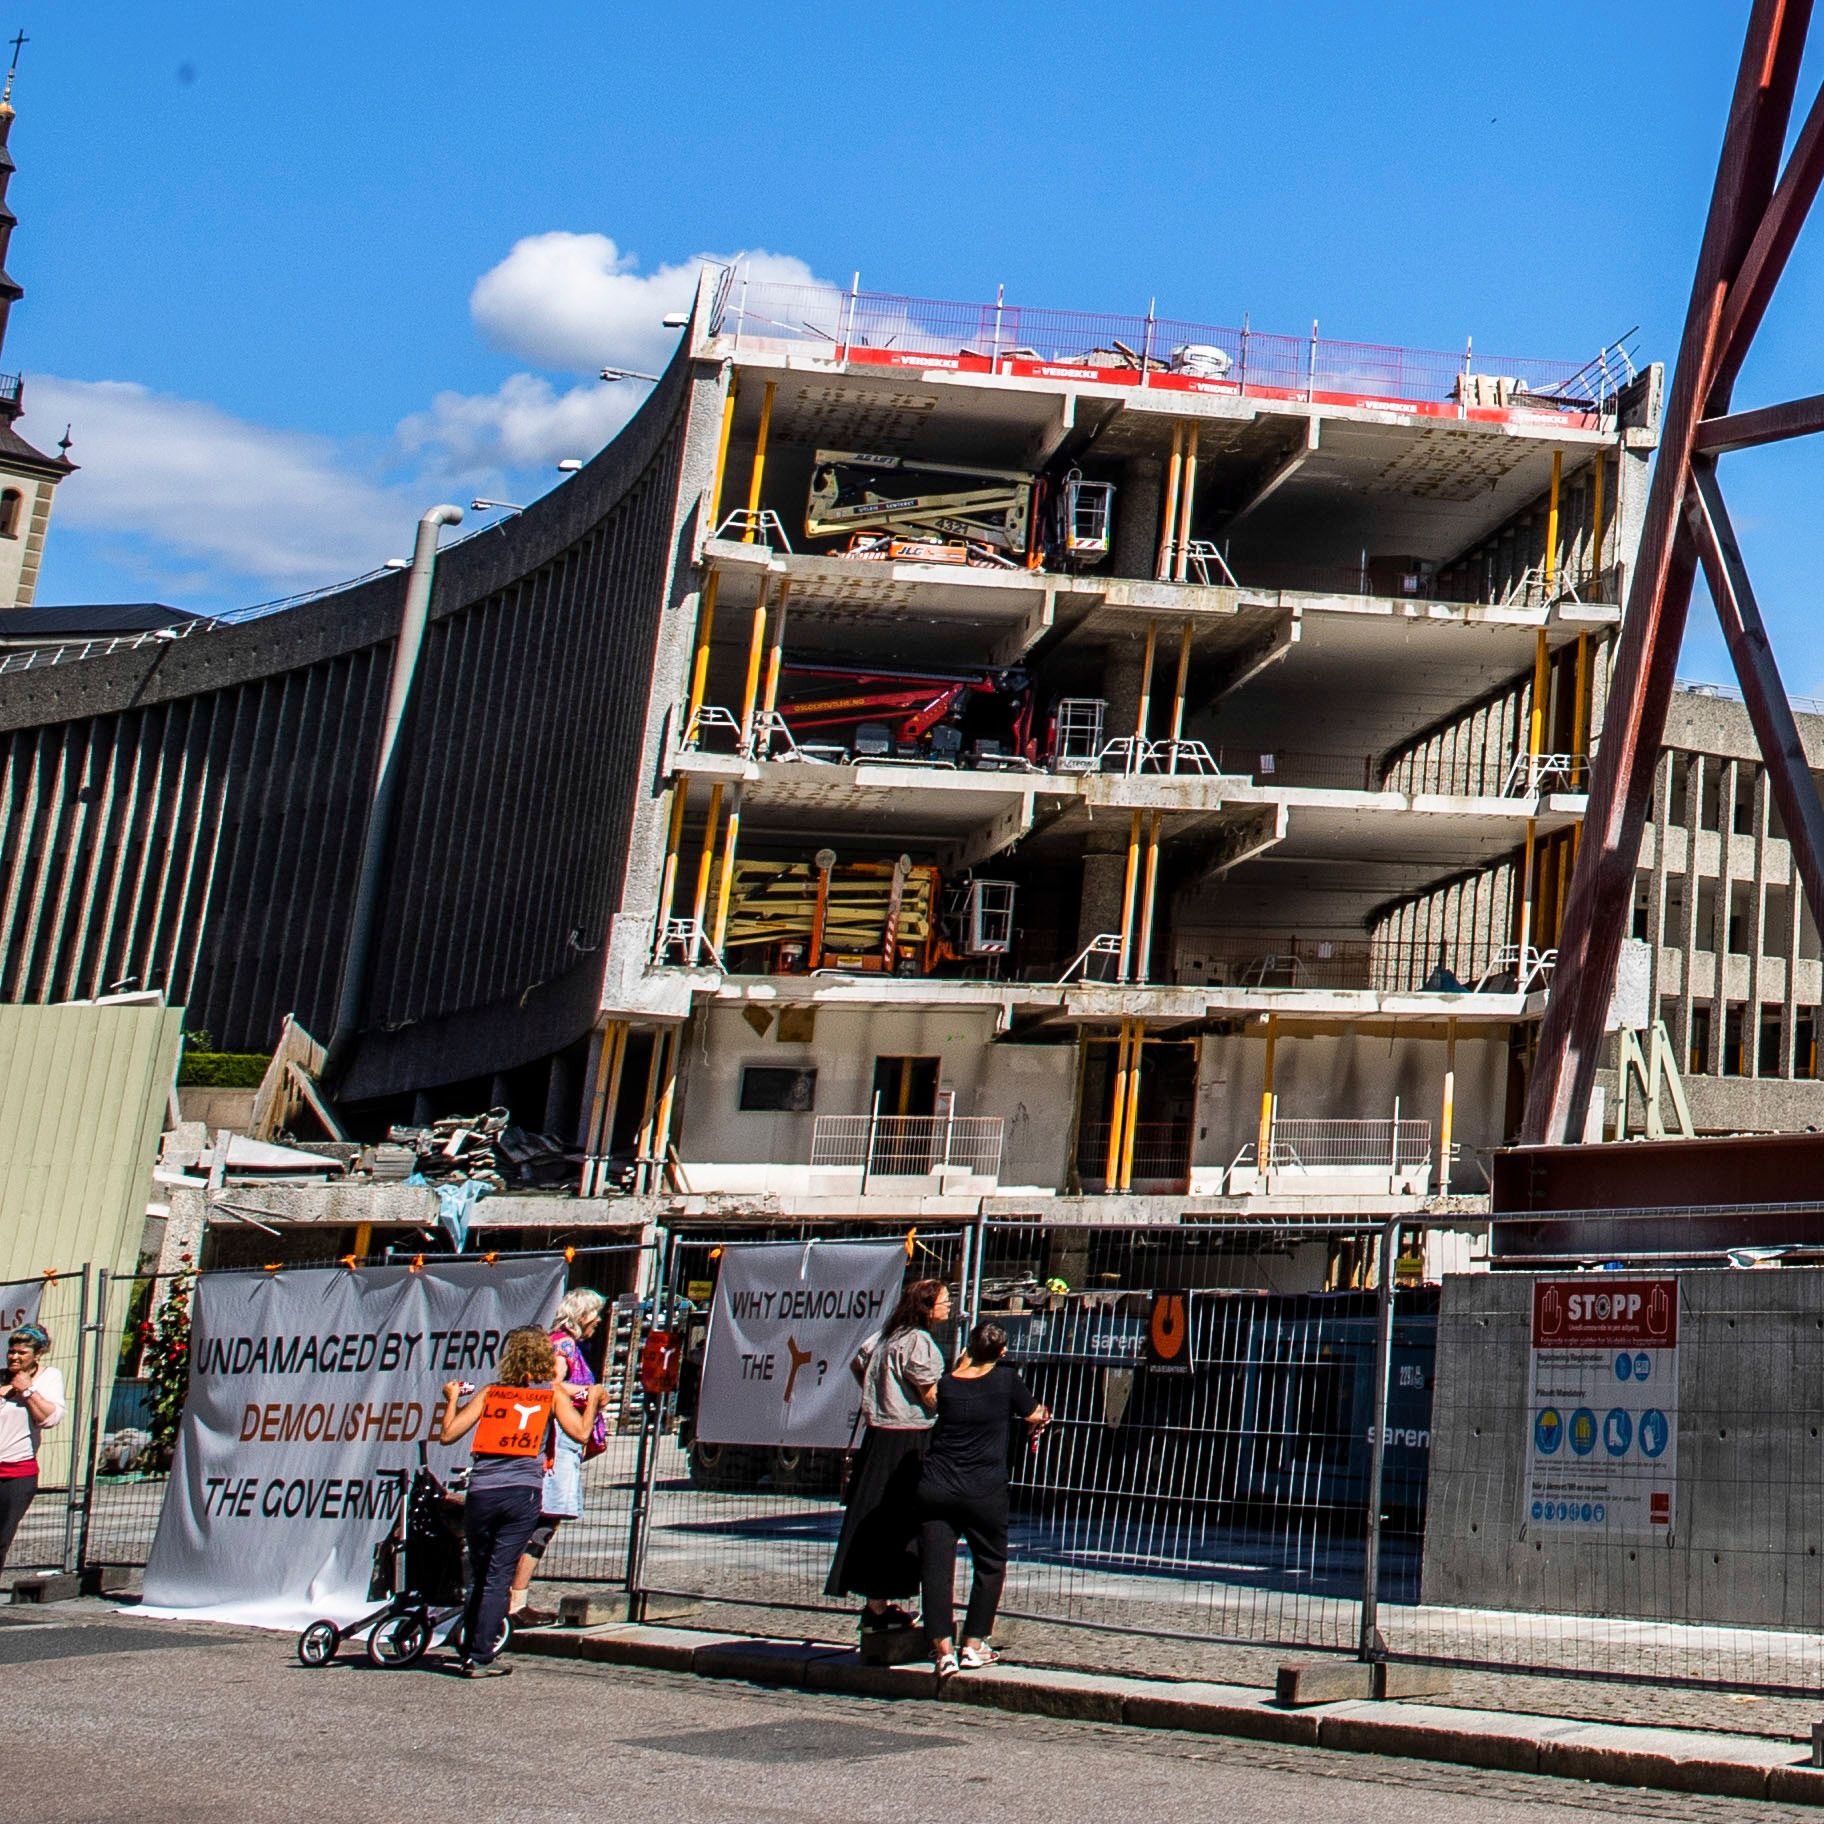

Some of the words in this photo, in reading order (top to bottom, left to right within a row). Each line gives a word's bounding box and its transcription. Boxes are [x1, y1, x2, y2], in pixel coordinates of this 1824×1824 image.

[935, 519, 970, 536] 4321
[897, 546, 924, 556] JLG
[732, 1289, 778, 1320] WHY
[778, 1289, 885, 1320] DEMOLISH
[1568, 1293, 1642, 1321] STOPP
[197, 1333, 378, 1375] UNDAMAGED
[379, 1331, 423, 1372] BY
[741, 1354, 775, 1381] THE
[238, 1402, 424, 1442] DEMOLISHED
[482, 1404, 508, 1419] La
[498, 1432, 539, 1449] stå!
[1367, 1426, 1430, 1448] saren
[204, 1477, 259, 1517] THE
